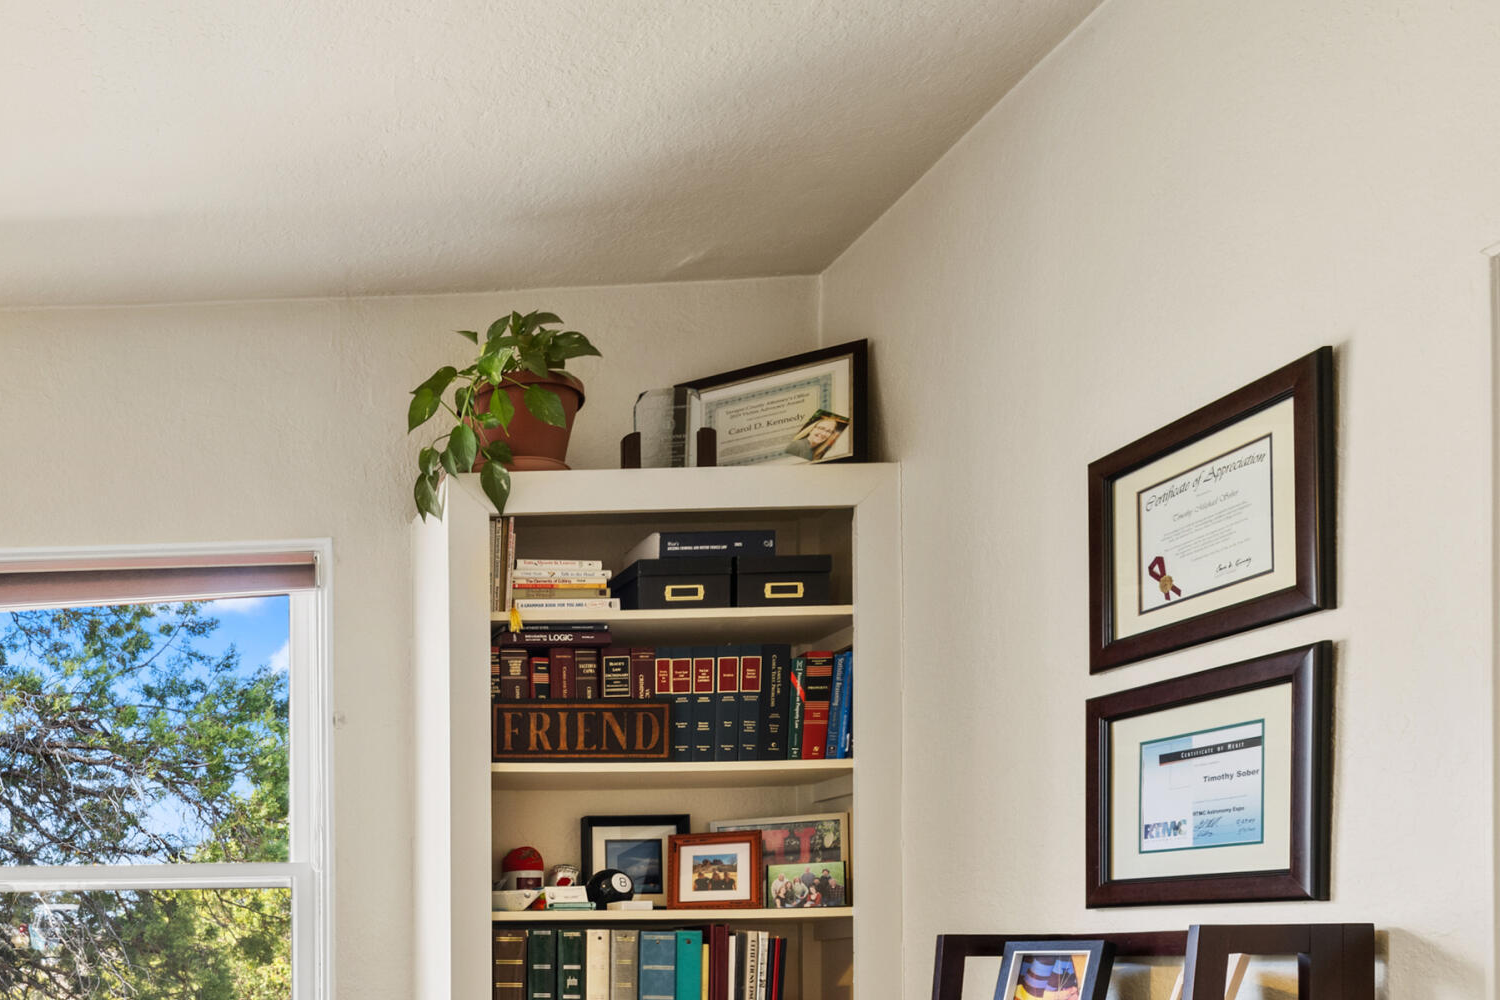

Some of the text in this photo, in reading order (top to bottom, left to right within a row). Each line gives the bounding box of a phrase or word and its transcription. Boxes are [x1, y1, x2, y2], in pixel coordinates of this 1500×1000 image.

[728, 422, 752, 436] Carol
[766, 413, 806, 428] Kennedy
[1145, 450, 1266, 512] Certificate of Appreciation
[549, 633, 573, 642] LOGIC
[503, 711, 660, 751] FRIEND
[1180, 745, 1214, 759] CERTIFICATE
[1227, 740, 1245, 750] MERIT
[1203, 767, 1260, 783] Timothy Sober
[1144, 819, 1187, 840] RTMC
[619, 877, 627, 887] 8
